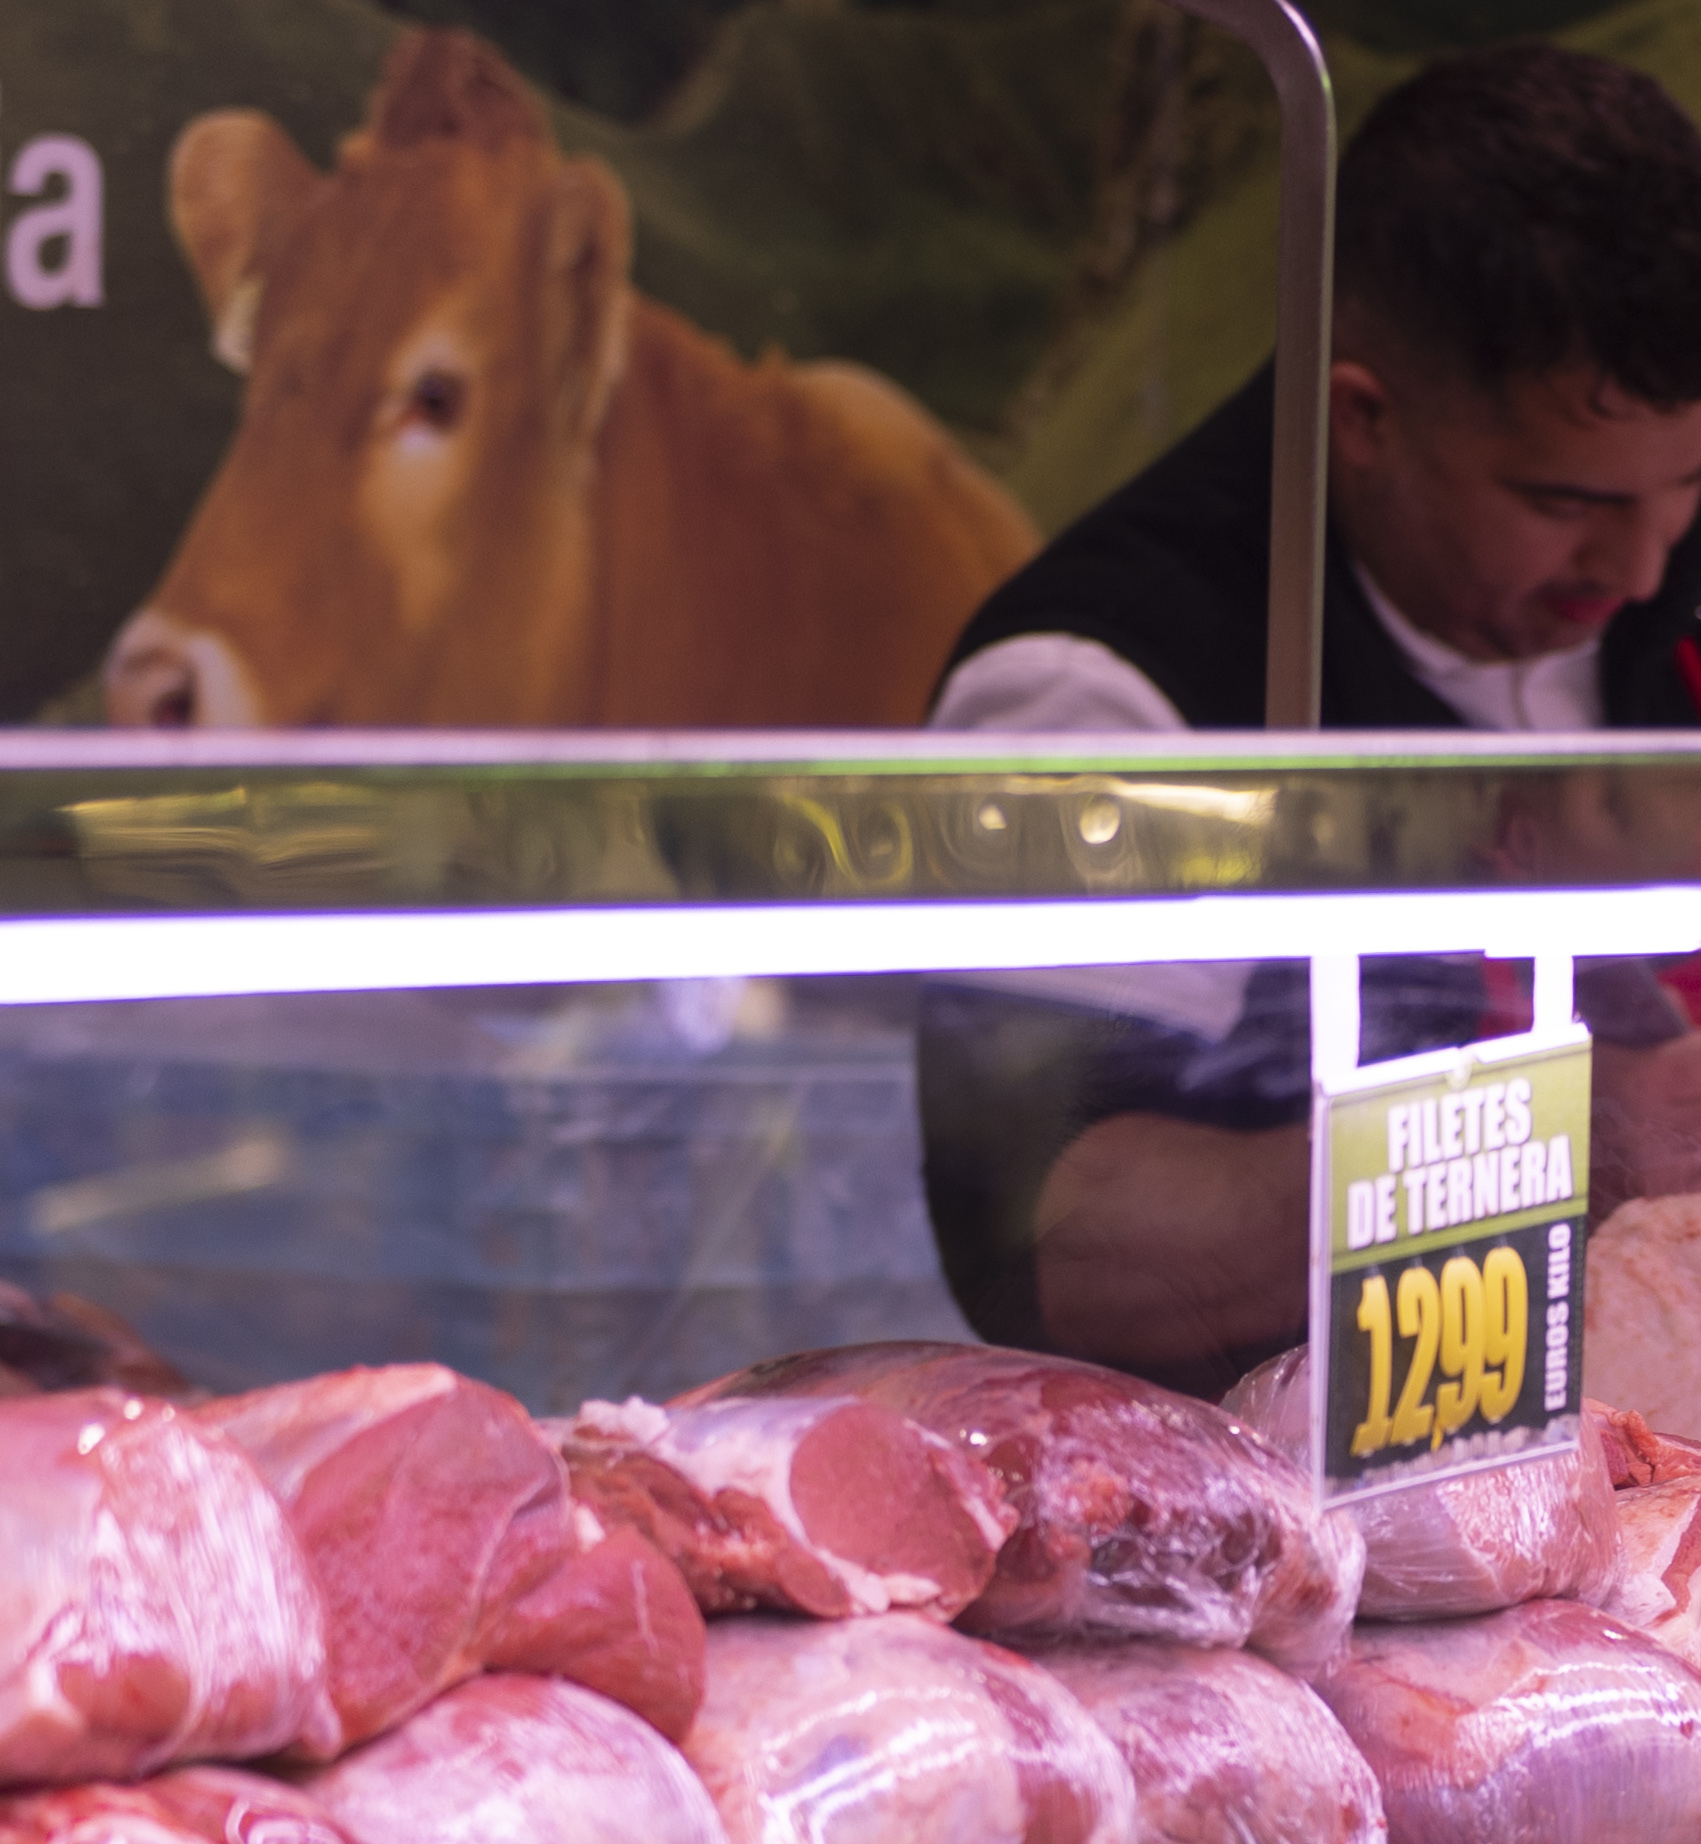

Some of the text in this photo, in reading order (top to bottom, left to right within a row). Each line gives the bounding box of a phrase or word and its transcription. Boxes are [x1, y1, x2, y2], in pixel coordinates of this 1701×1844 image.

[1387, 1078, 1533, 1173] FILETES
[1347, 1135, 1574, 1250] DE TERNERA
[1545, 1223, 1571, 1411] EUROS KILO
